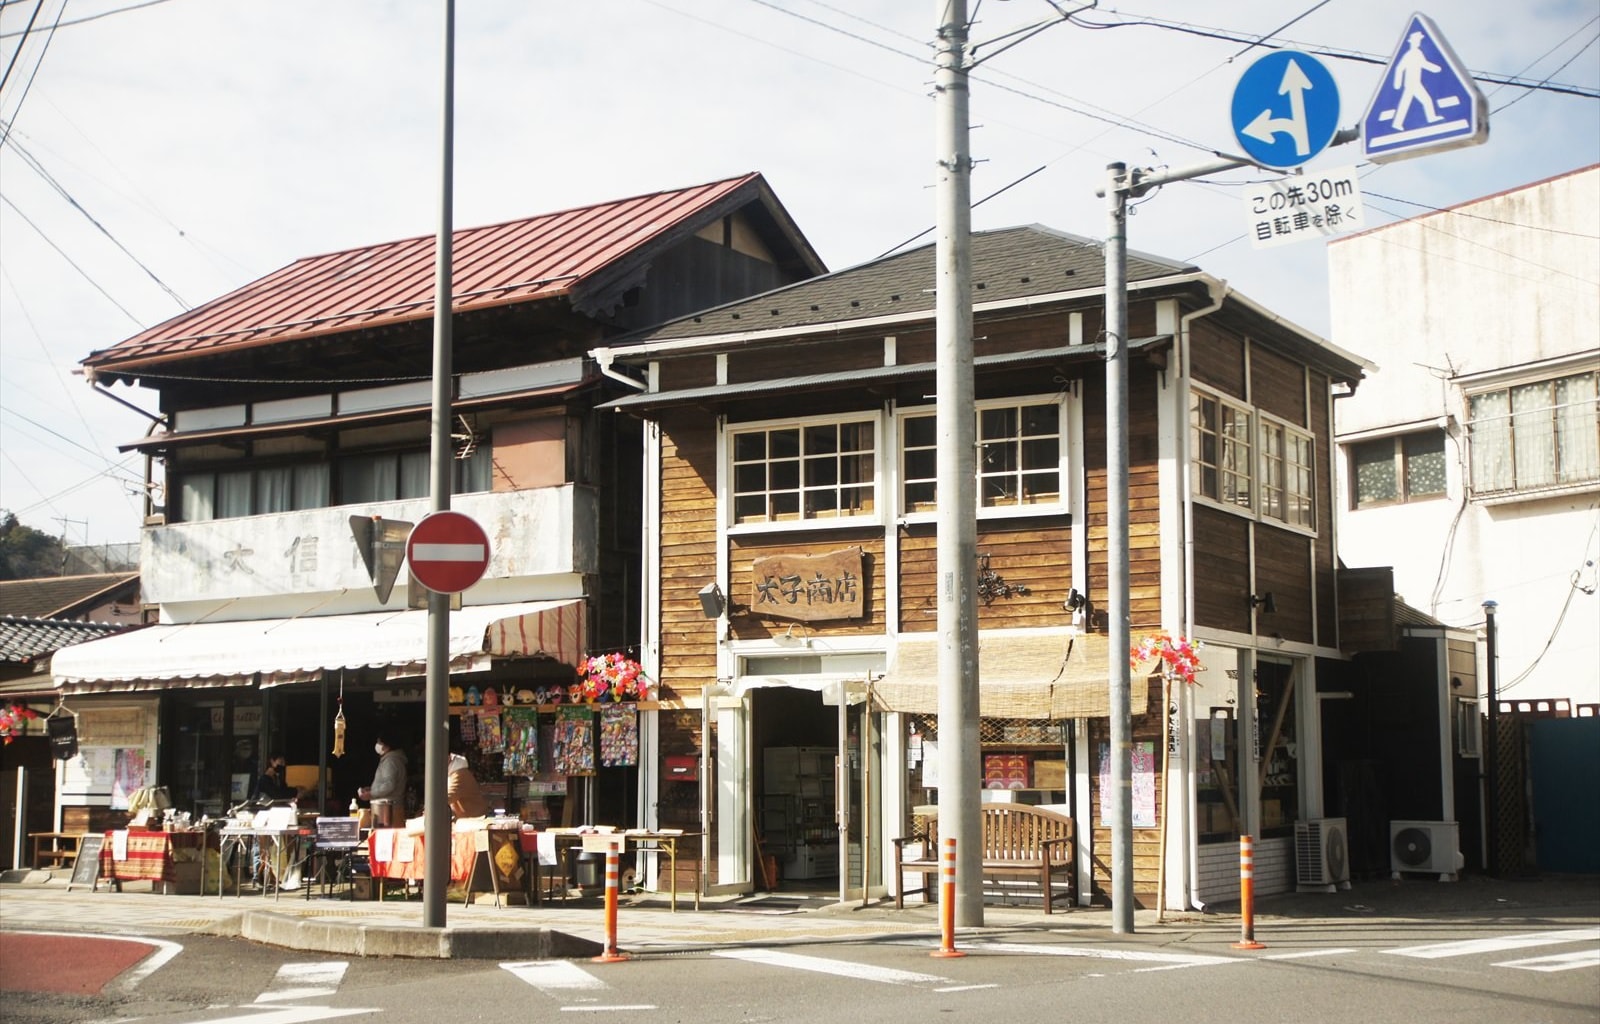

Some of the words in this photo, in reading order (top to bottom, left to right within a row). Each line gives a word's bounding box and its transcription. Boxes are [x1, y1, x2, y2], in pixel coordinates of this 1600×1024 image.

[1252, 178, 1353, 215] この先30m
[1256, 203, 1357, 241] 自転車を除く
